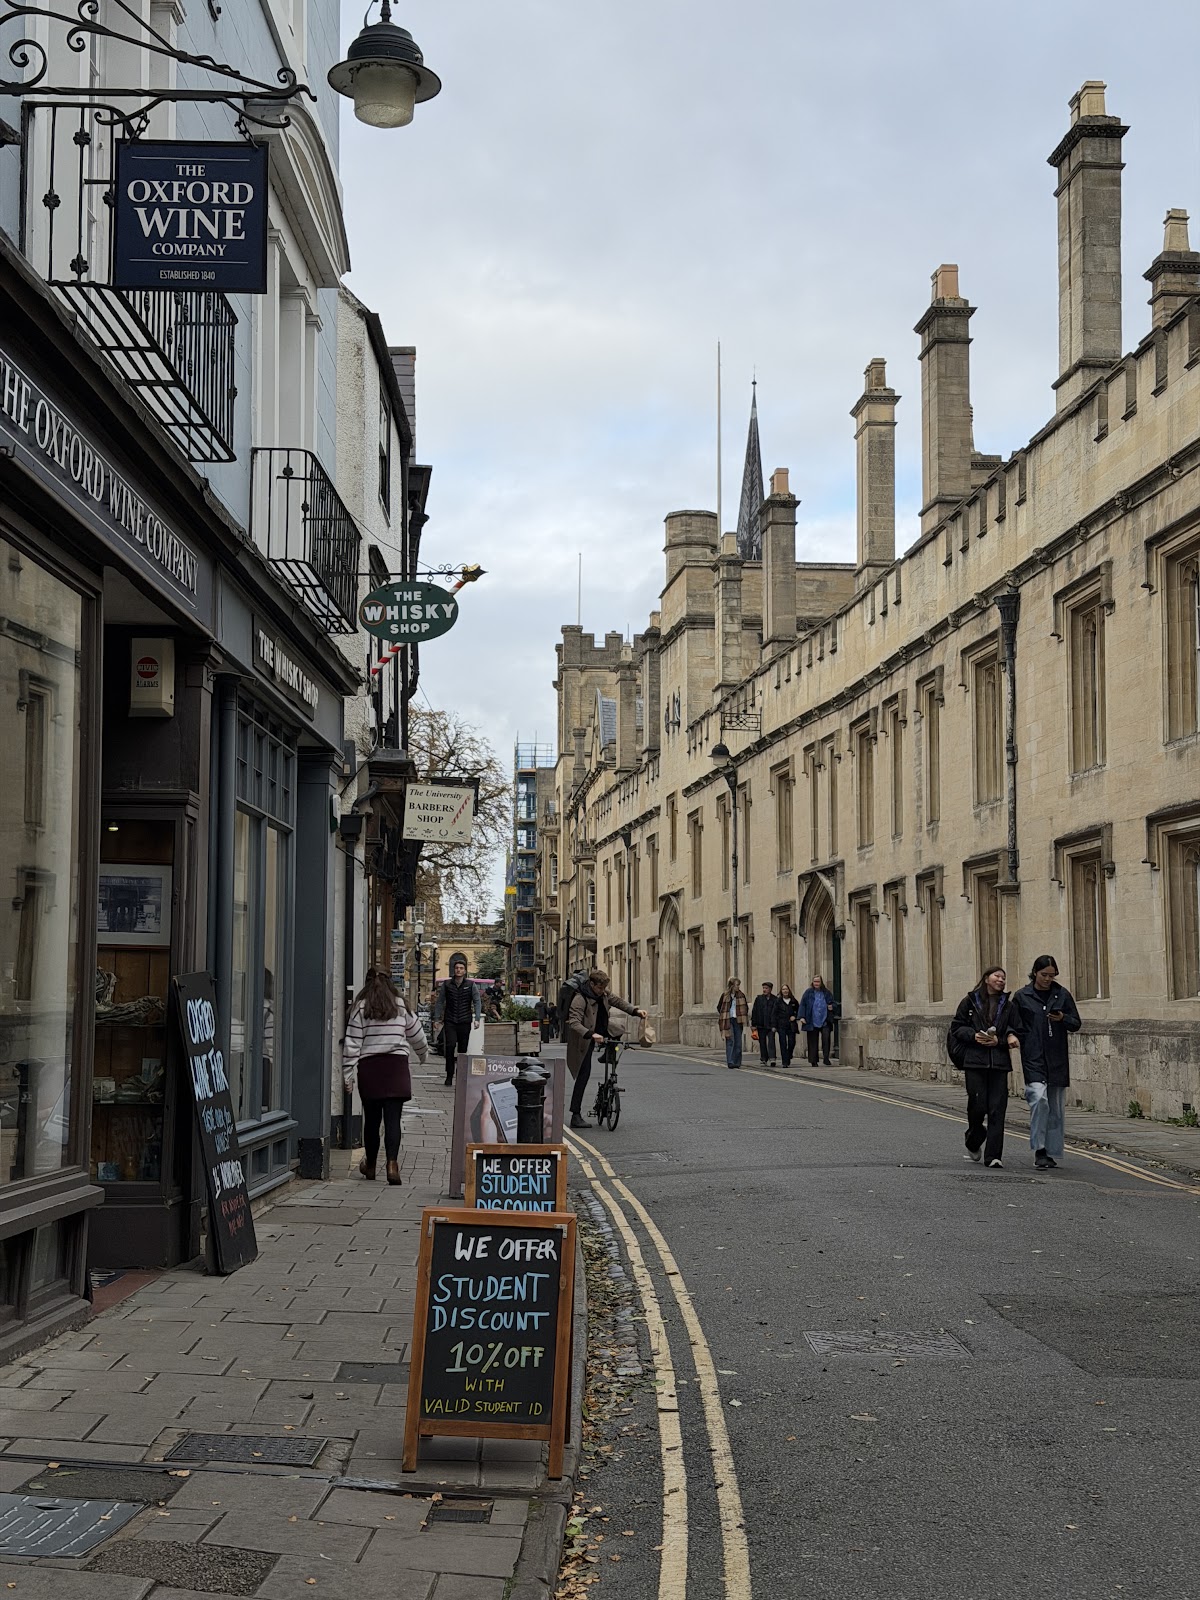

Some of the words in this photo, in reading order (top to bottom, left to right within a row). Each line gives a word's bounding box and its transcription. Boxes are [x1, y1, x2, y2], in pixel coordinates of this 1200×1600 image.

[176, 165, 205, 176] THE
[127, 180, 254, 204] OXFORD
[134, 207, 246, 240] WINE
[152, 243, 227, 256] COMPANY
[159, 270, 199, 280] ESTABLISHED
[201, 271, 216, 280] 1840
[35, 398, 105, 502] OXFORD
[108, 469, 145, 545] WINE
[146, 513, 199, 596] COMPANY
[394, 591, 422, 601] THE
[364, 603, 455, 621] WHISKY
[390, 623, 430, 634] SHOP
[259, 629, 274, 668] THE
[274, 645, 303, 694] WHISKY
[303, 675, 319, 709] SHOP
[426, 790, 463, 800] University
[409, 802, 455, 812] BARBERS
[417, 815, 444, 823] SHOP
[187, 998, 216, 1045] OXFORD
[487, 1064, 507, 1073] 10%
[482, 1158, 501, 1173] WE
[510, 1158, 551, 1174] OFFER
[481, 1174, 551, 1194] STUDENT
[454, 1232, 492, 1261] WE
[498, 1238, 557, 1262] OFFER
[433, 1272, 550, 1302] STUDENT
[431, 1306, 550, 1332] DISCOUNT
[465, 1376, 505, 1392] WITH
[425, 1398, 470, 1413] VALID
[474, 1401, 522, 1415] STUDENT
[529, 1402, 543, 1415] ID
